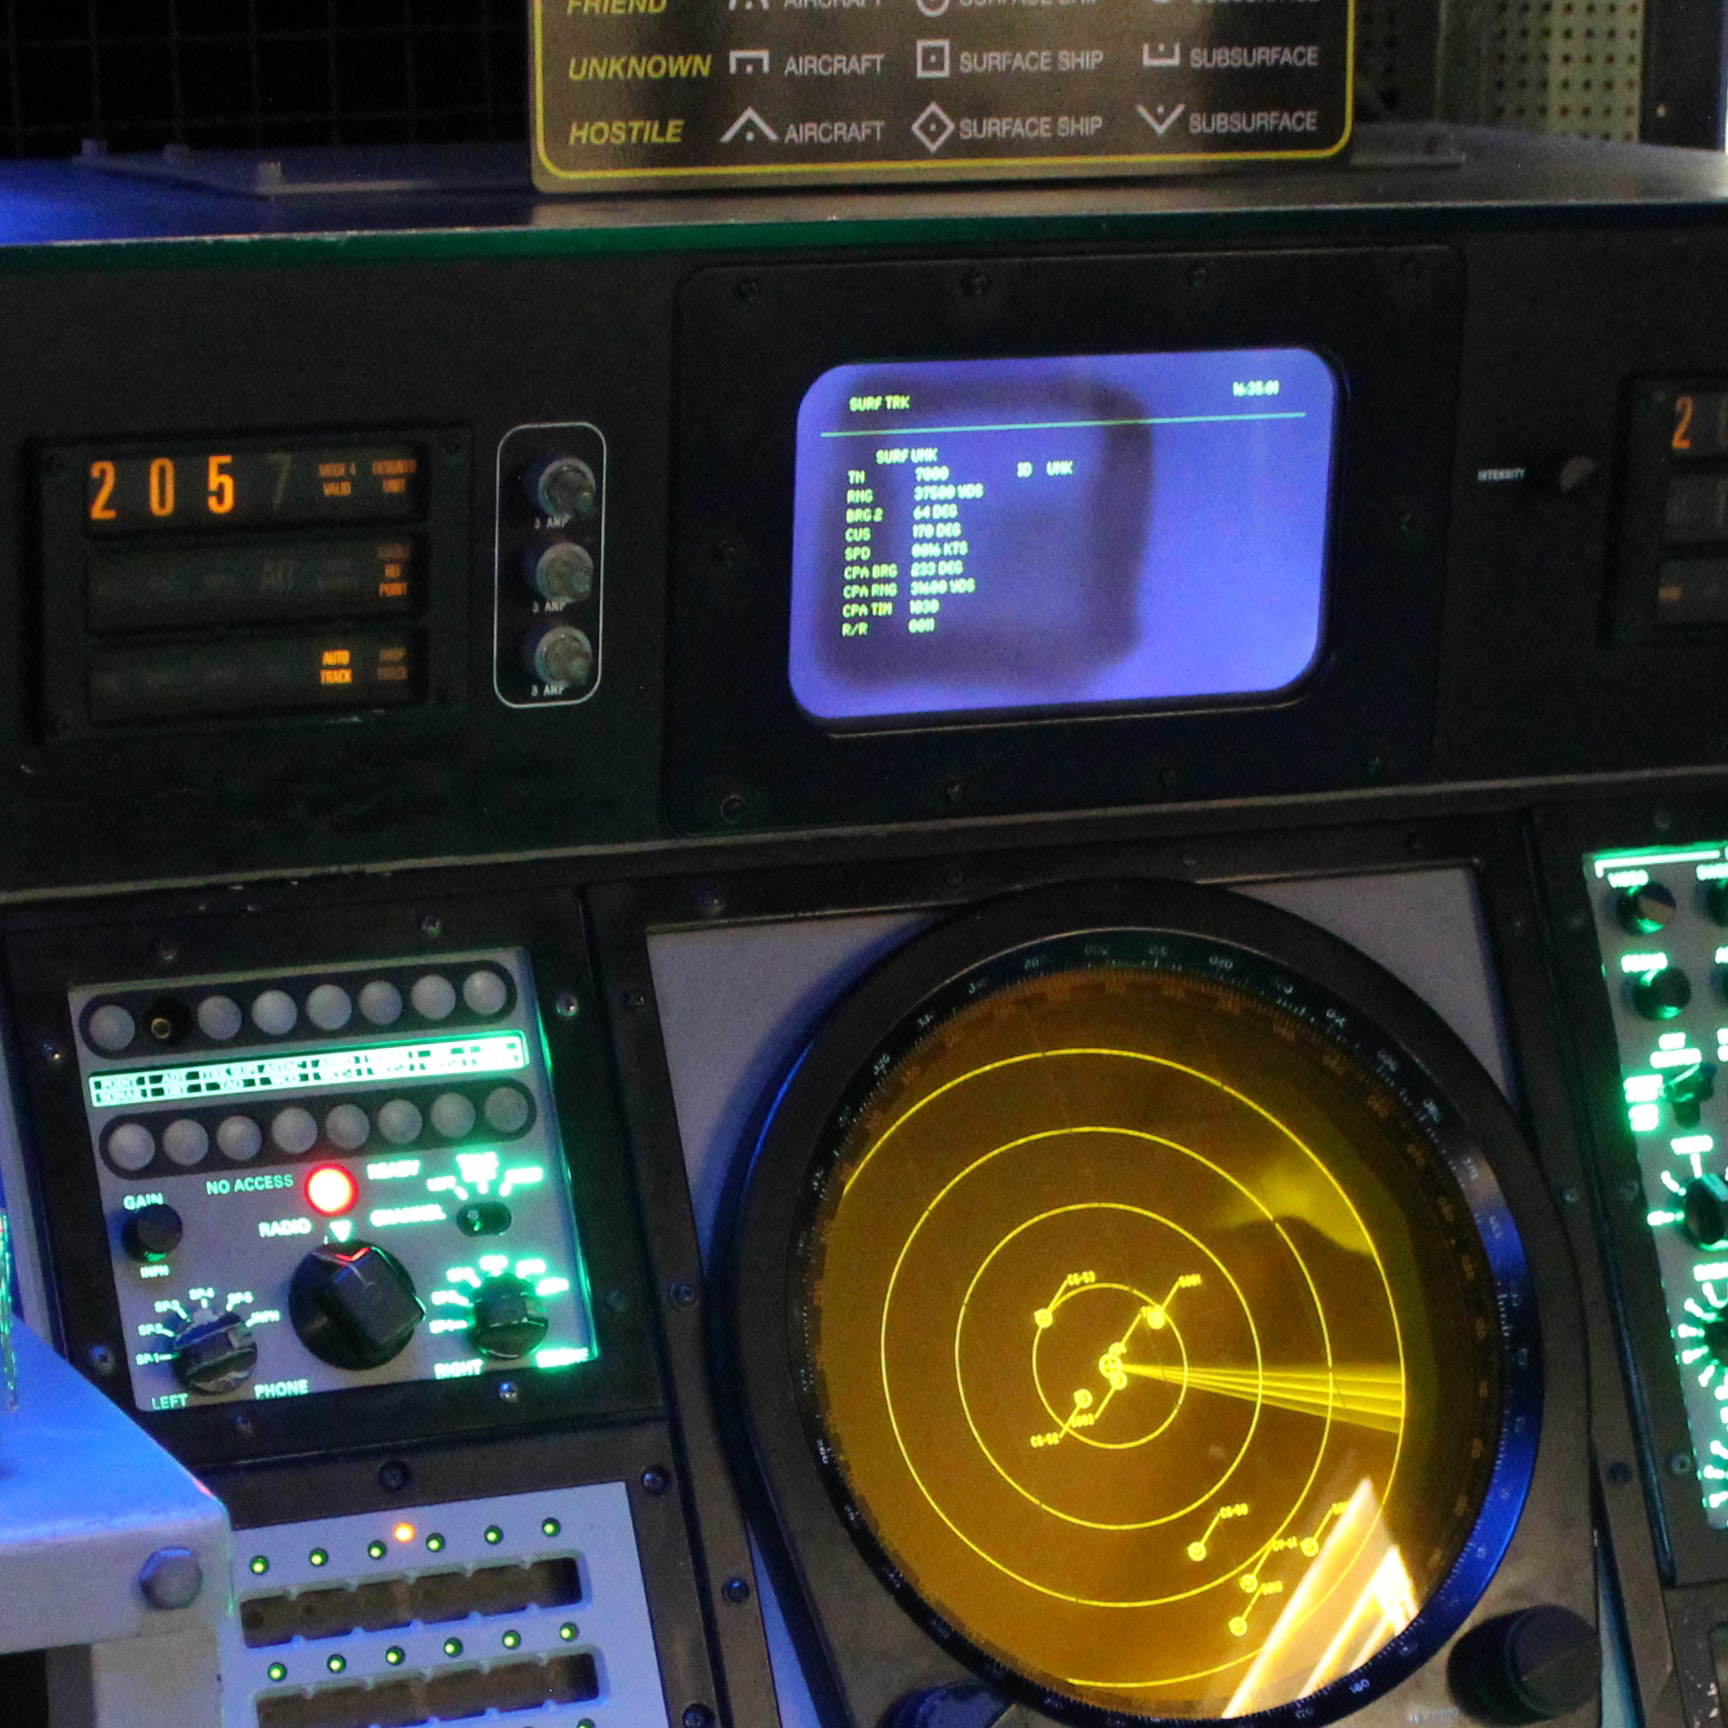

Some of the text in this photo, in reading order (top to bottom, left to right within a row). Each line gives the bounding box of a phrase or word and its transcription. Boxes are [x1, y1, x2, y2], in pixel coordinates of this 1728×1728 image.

[569, 44, 1320, 80] UNKNOWN AIRCRAFT SURFACE SHIP SUBSURFACE
[569, 110, 1318, 146] HOSTILE AIRCRAFT SURFACE SHIP SUBSURFACE
[885, 395, 911, 410] TRK
[1672, 396, 1694, 449] 2
[932, 503, 959, 519] DEG
[843, 566, 870, 580] CPA
[843, 585, 869, 599] CPA
[842, 603, 869, 618] CPA
[322, 650, 351, 666] AUTO
[320, 668, 353, 685] TRACK
[206, 1173, 294, 1195] NO ACCESS
[122, 1192, 164, 1211] GAIN
[258, 1217, 312, 1238] RADIO
[434, 1358, 484, 1380] RIGHT
[254, 1378, 310, 1400] PHONE
[151, 1392, 189, 1411] LEFT
